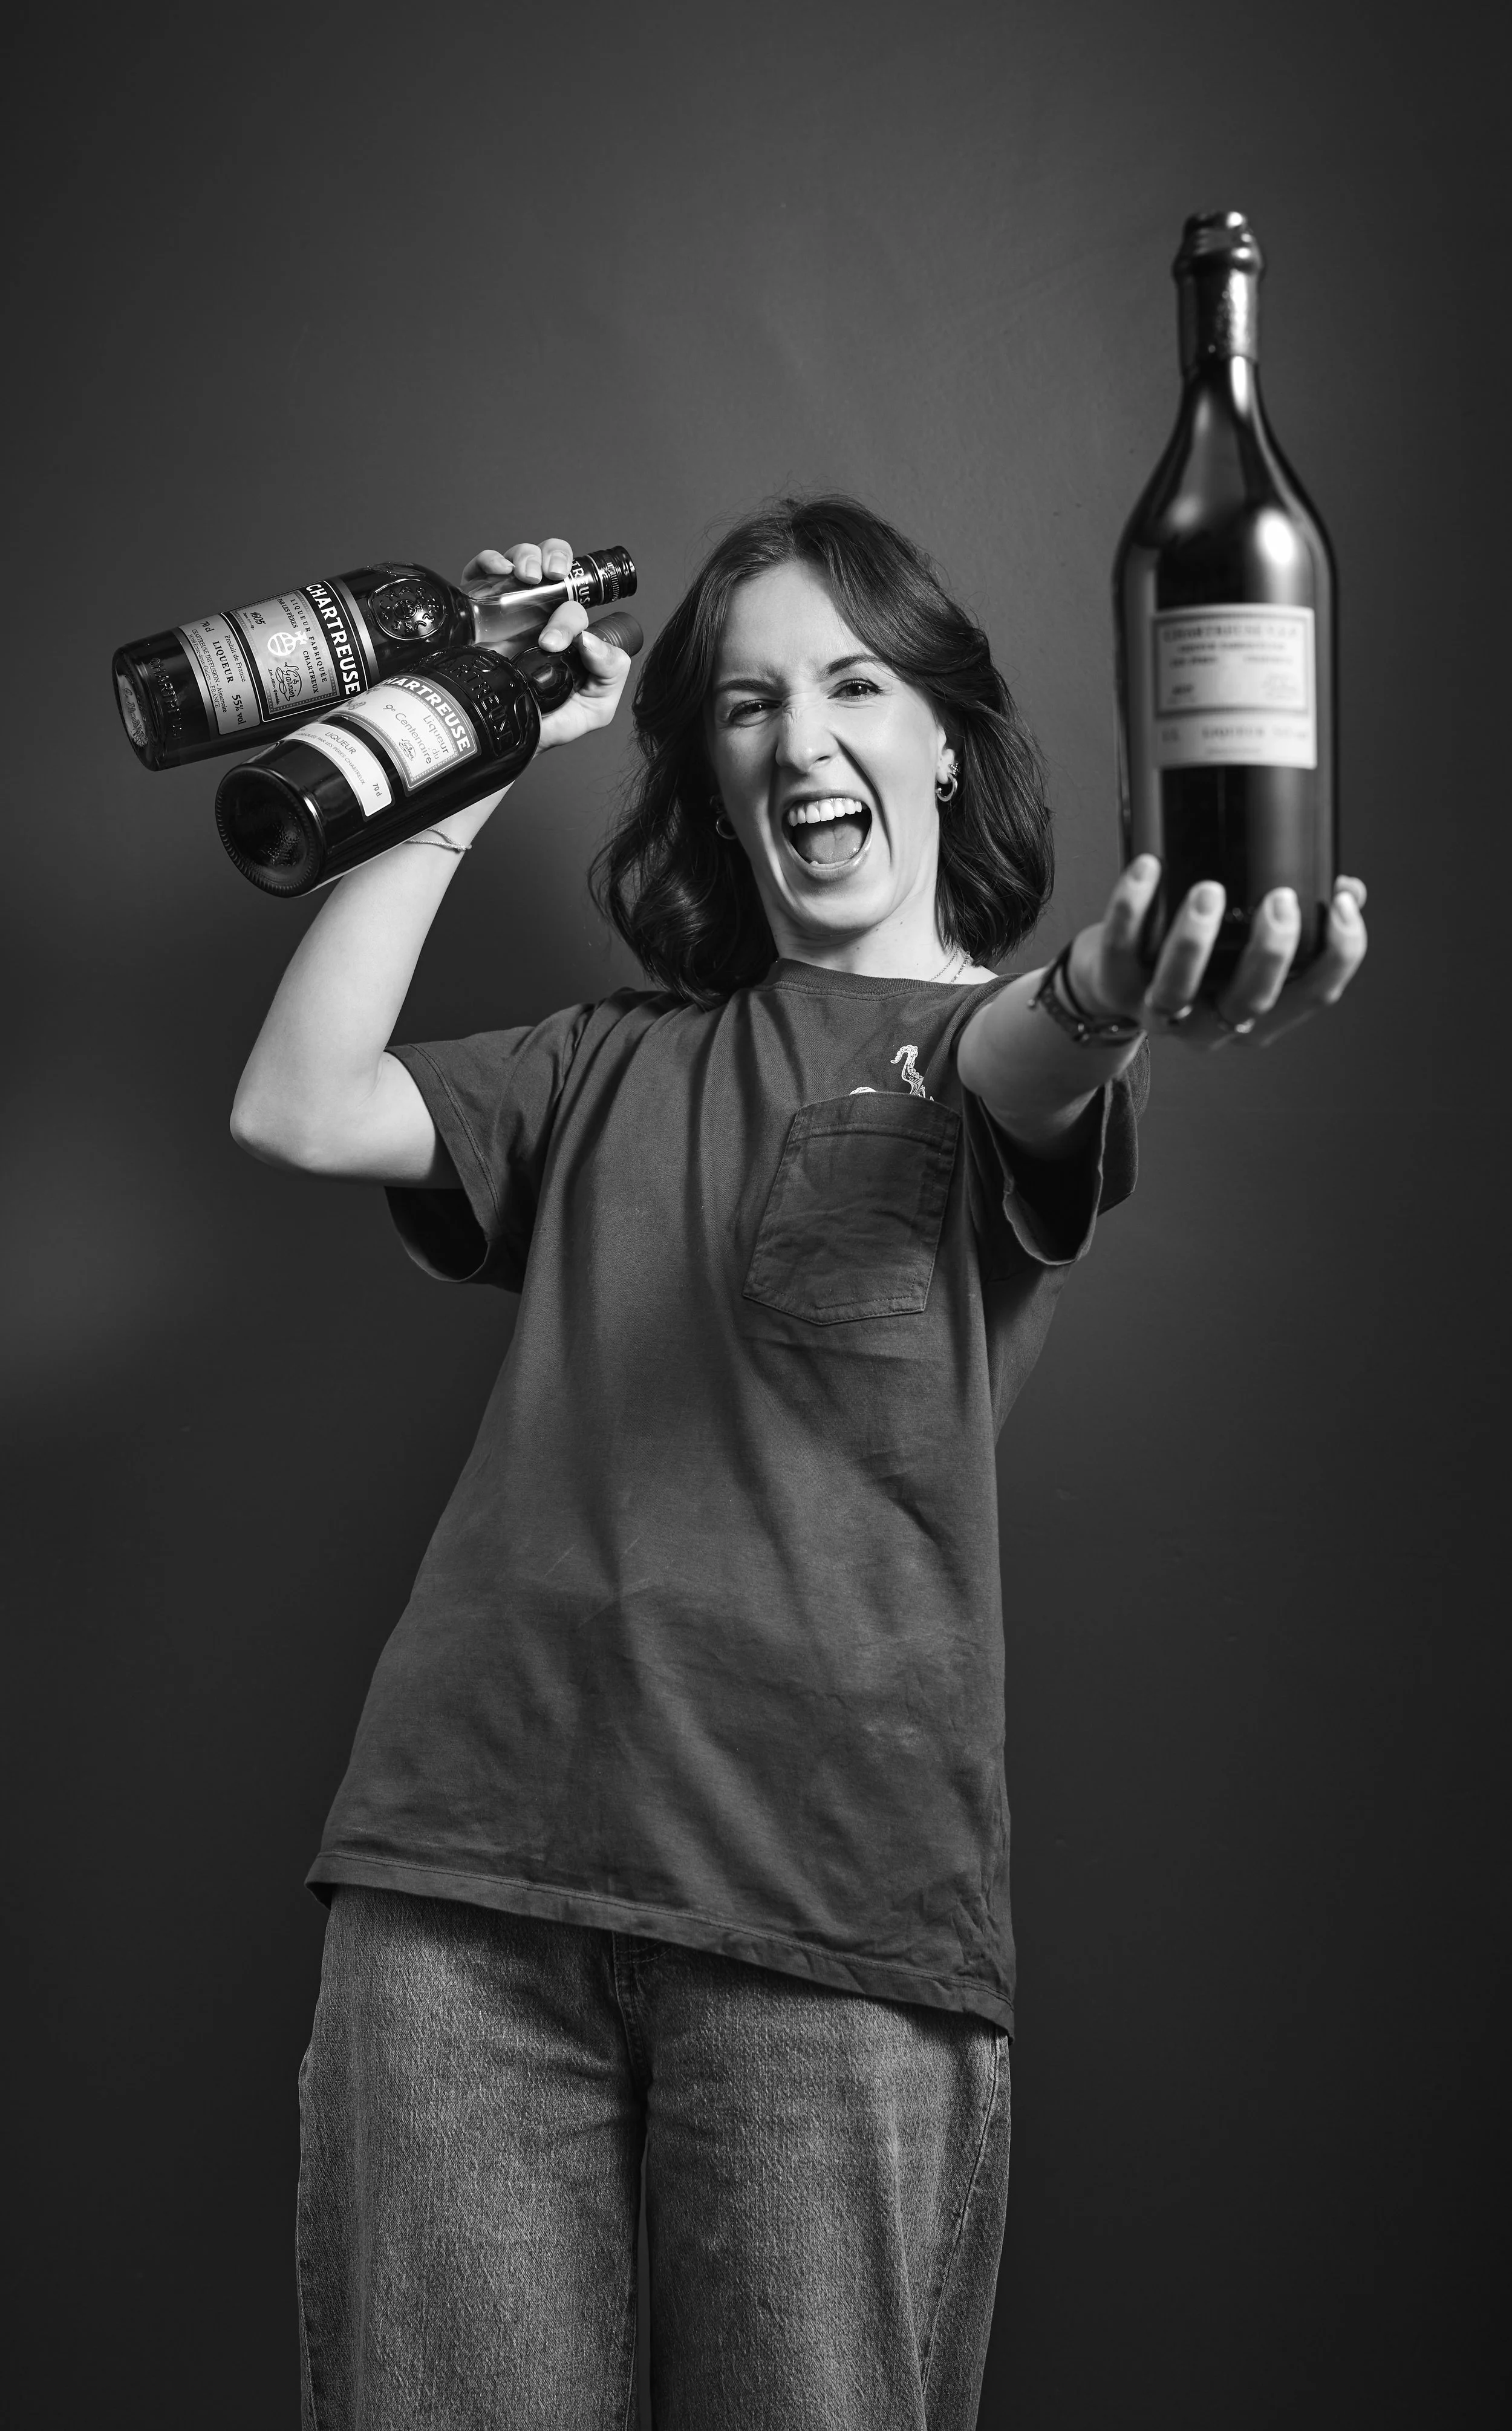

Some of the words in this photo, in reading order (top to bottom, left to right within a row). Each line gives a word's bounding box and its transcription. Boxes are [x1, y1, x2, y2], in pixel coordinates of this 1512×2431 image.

[250, 612, 266, 625] 1605
[225, 635, 235, 653] Produit
[236, 662, 246, 682] France
[287, 612, 298, 628] PÈRES
[303, 650, 319, 694] CHARTREUX
[290, 599, 311, 632] LIQUEUR
[308, 636, 327, 683] FABRIQUÉE
[306, 584, 360, 695] CHARTREUSE
[192, 629, 209, 654] CHARTREUSE
[206, 655, 220, 683] DIFFUSION
[217, 687, 227, 713] Aiguenoire
[212, 641, 234, 684] LIQUEUR
[209, 685, 221, 708] FRANCE
[232, 694, 244, 711] 55%
[236, 713, 247, 725] vol
[423, 714, 449, 754] Liqueur
[325, 731, 356, 754] LIQUEUR
[395, 713, 432, 765] Centenaire
[432, 748, 440, 760] du
[333, 746, 347, 758] PÈRES
[345, 757, 365, 785] CHARTREUX
[373, 783, 380, 791] 70
